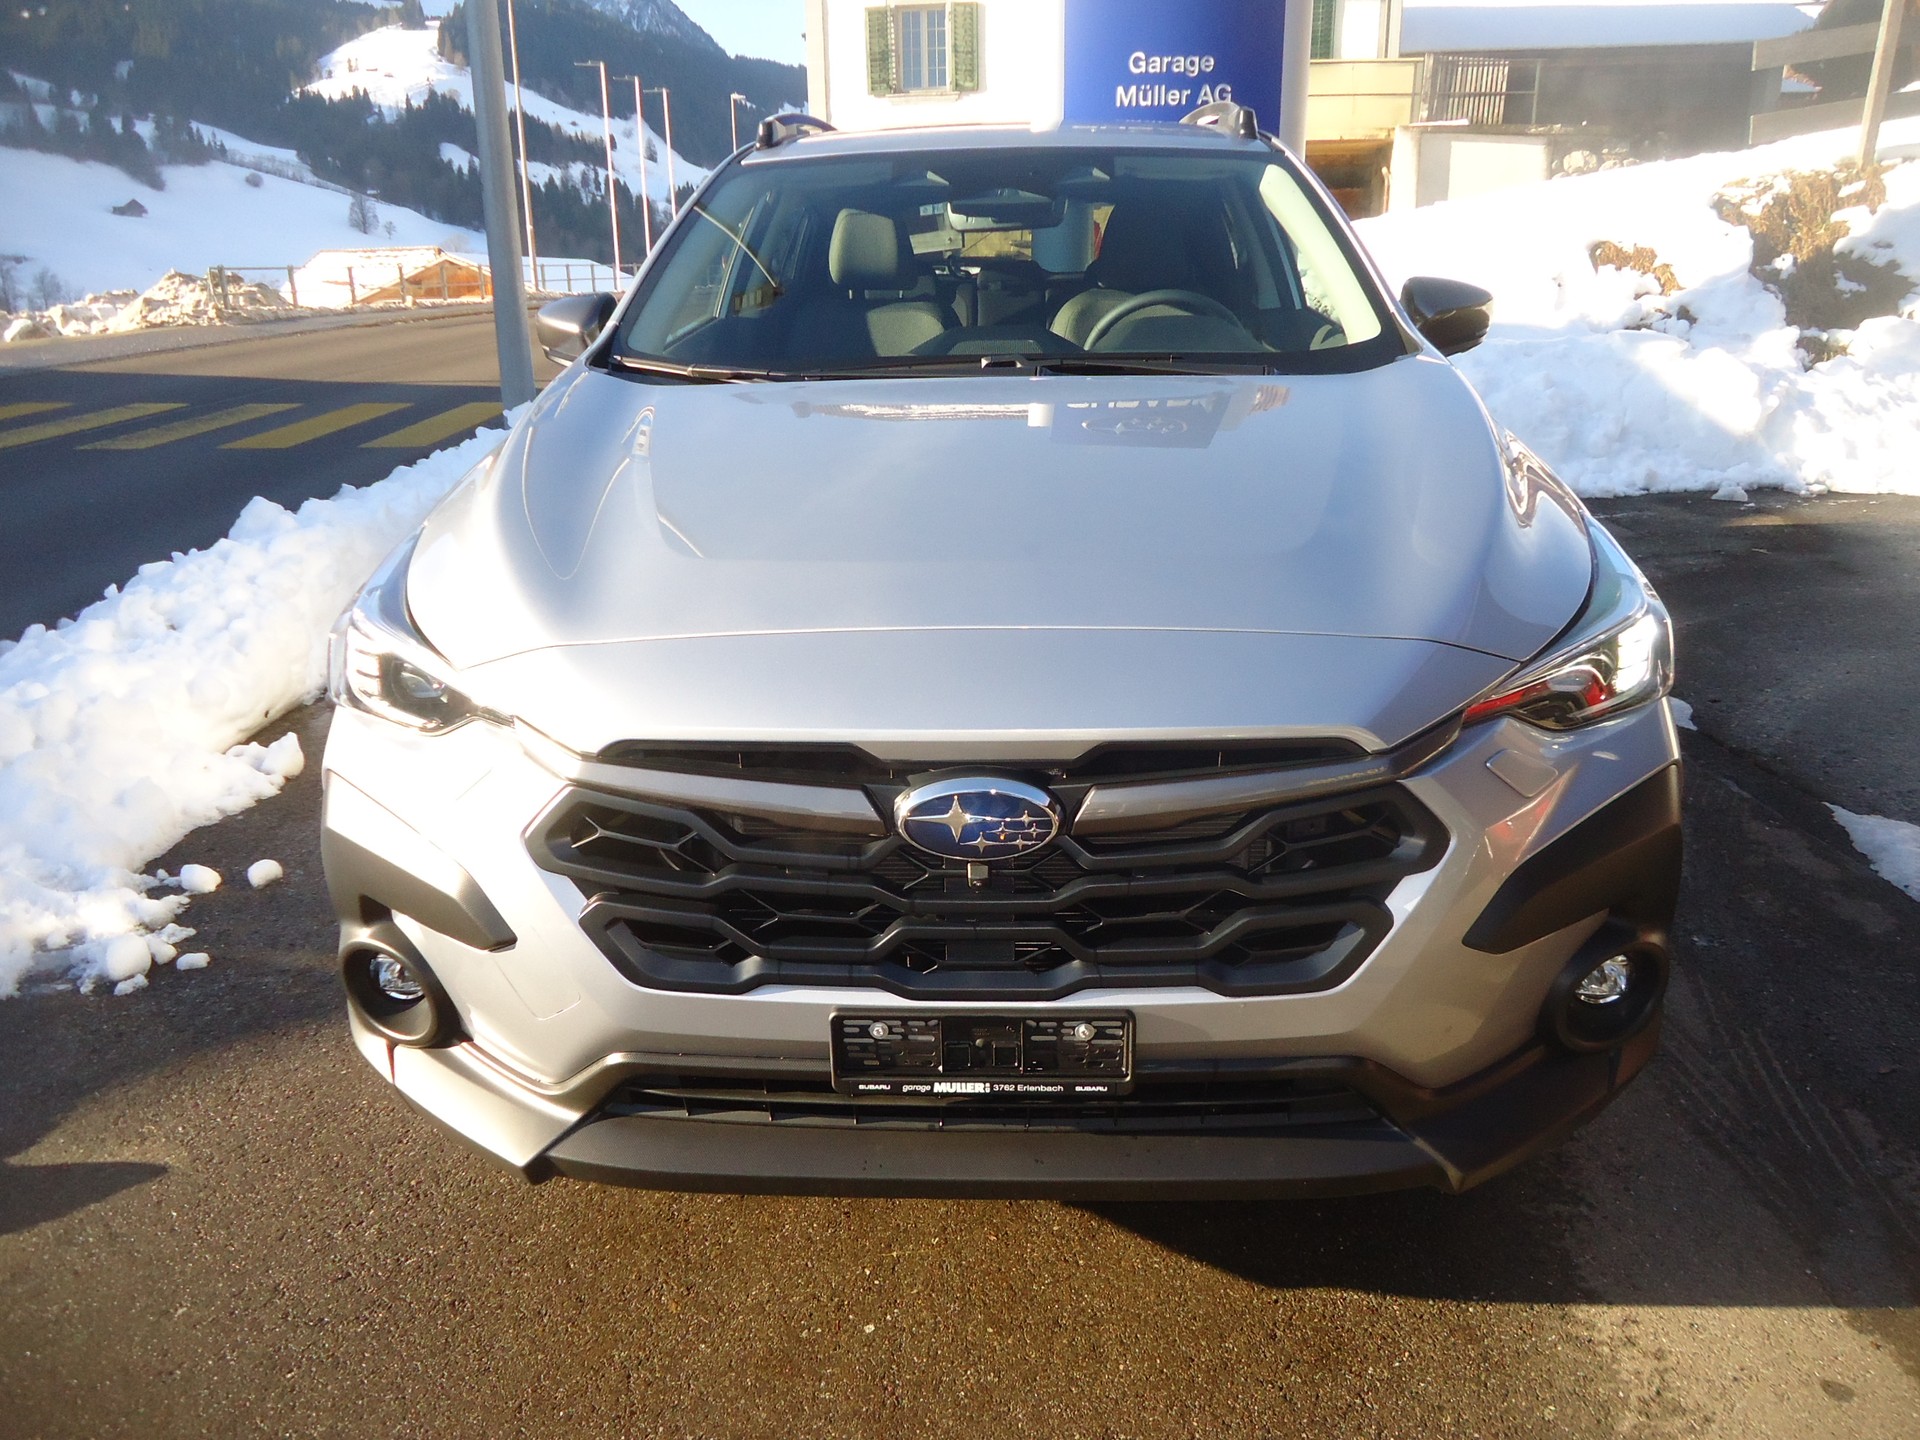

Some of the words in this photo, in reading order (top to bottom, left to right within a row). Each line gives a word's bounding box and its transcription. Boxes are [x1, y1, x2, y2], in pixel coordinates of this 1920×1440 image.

[1128, 51, 1215, 77] Garage
[1115, 84, 1191, 108] Müller
[1196, 83, 1232, 105] AG
[902, 1084, 931, 1093] garage
[993, 1084, 1015, 1092] 3762
[1017, 1084, 1064, 1092] Erlenbach
